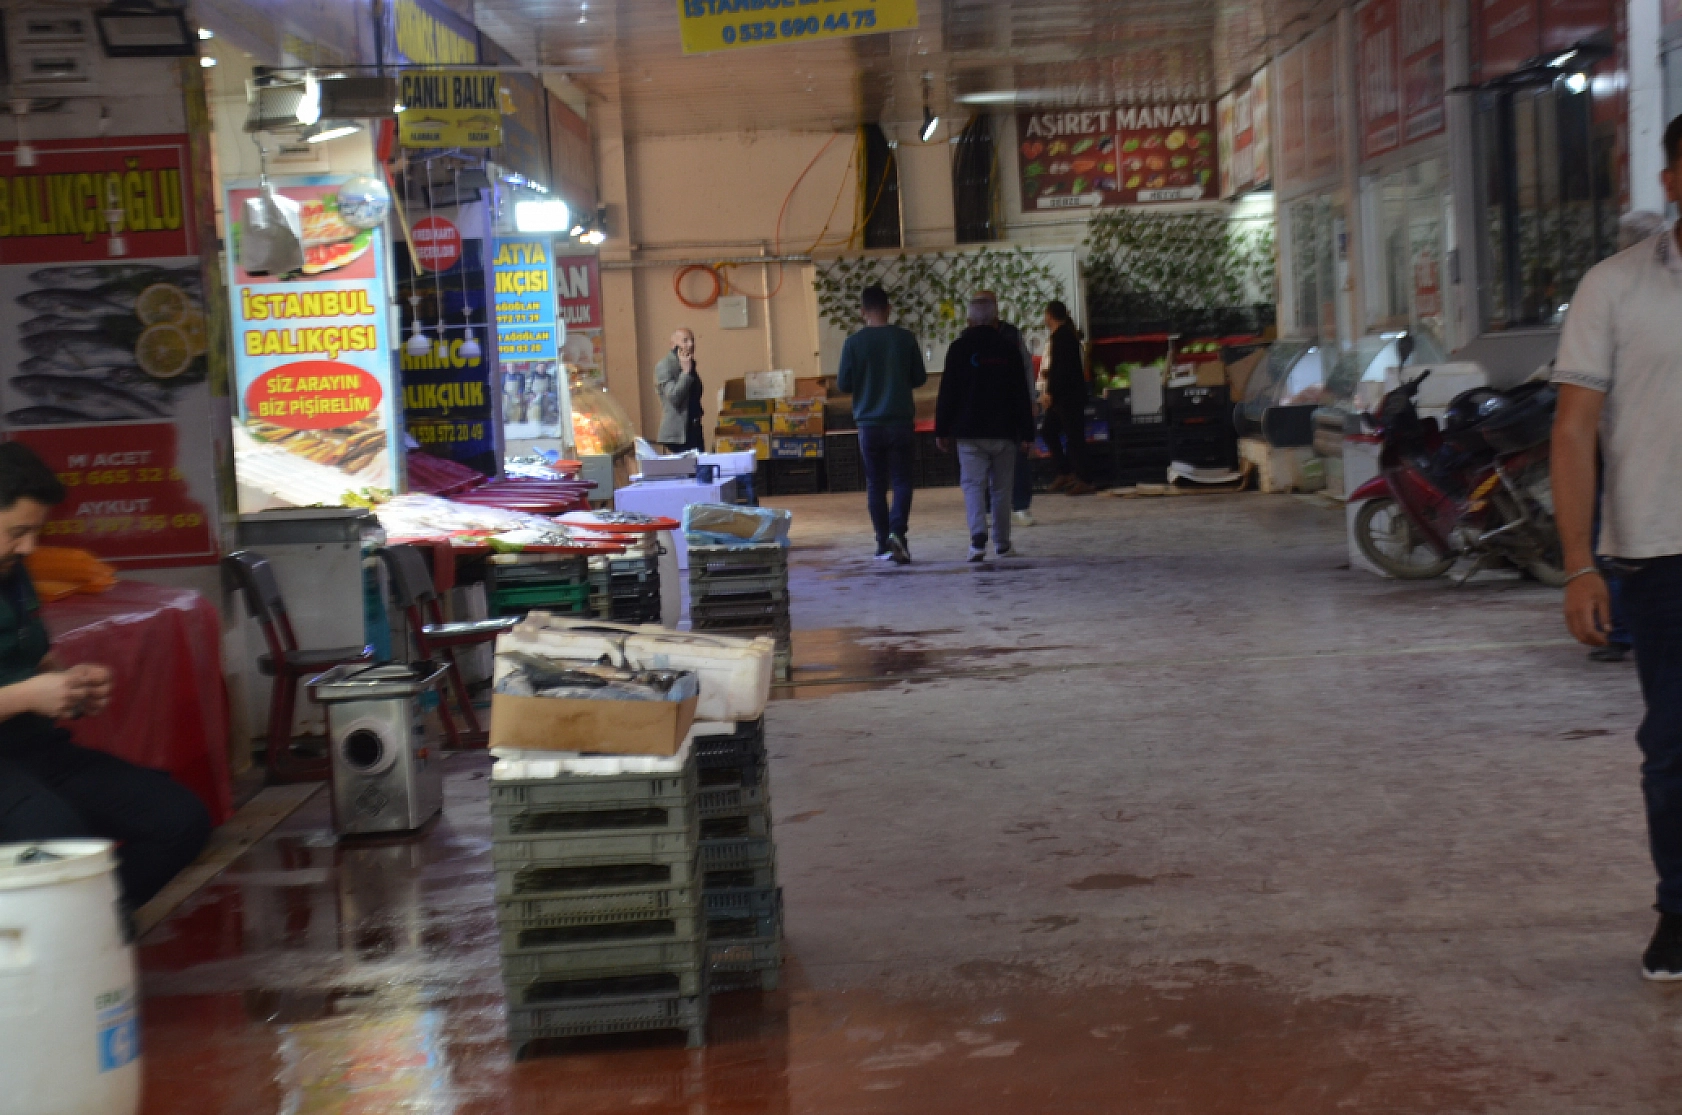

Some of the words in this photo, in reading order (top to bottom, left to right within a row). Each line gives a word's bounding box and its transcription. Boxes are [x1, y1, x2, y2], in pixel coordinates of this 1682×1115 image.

[723, 25, 736, 44] 0
[740, 20, 777, 43] 532
[780, 16, 819, 38] 690
[823, 12, 850, 32] 44
[852, 8, 877, 29] 75
[402, 75, 448, 109] CANLI
[453, 75, 497, 109] BALIK
[494, 269, 548, 297] IKÇISI
[241, 288, 375, 320] İSTANBUL
[244, 324, 376, 360] BALIKÇISI
[267, 374, 293, 393] SİZ
[296, 374, 361, 392] ARAYIN
[258, 398, 286, 417] BİZ
[290, 394, 371, 419] PİŞİRELİM
[92, 451, 151, 467] ACET
[75, 497, 152, 516] AYKUT
